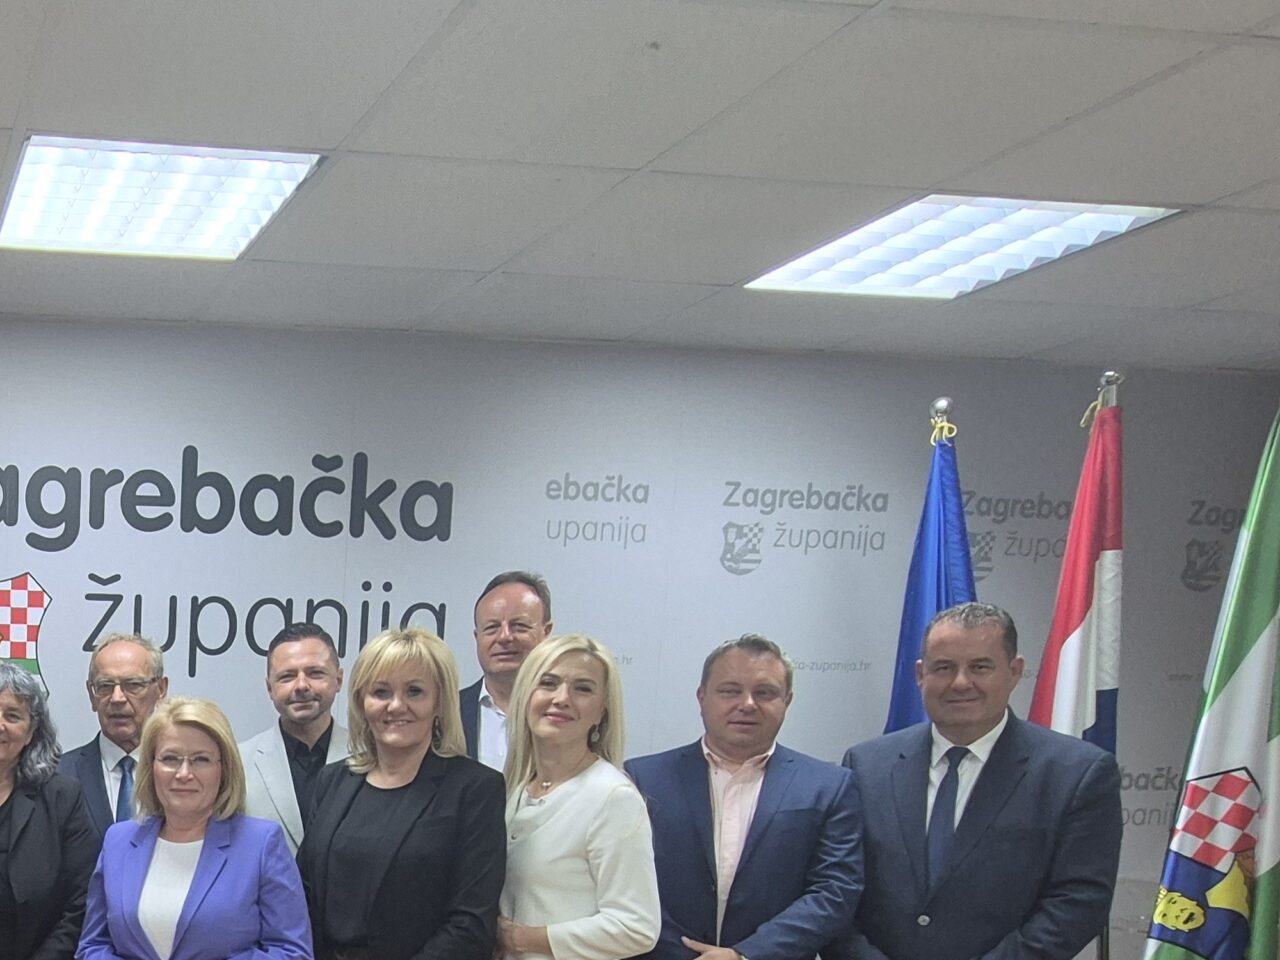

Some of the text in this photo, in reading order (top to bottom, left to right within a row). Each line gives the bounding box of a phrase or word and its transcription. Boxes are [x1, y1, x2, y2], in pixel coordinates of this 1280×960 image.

[545, 472, 650, 505] ebačka
[723, 481, 889, 514] Zagrebačka
[546, 516, 648, 549] upanija
[773, 522, 885, 556] županija
